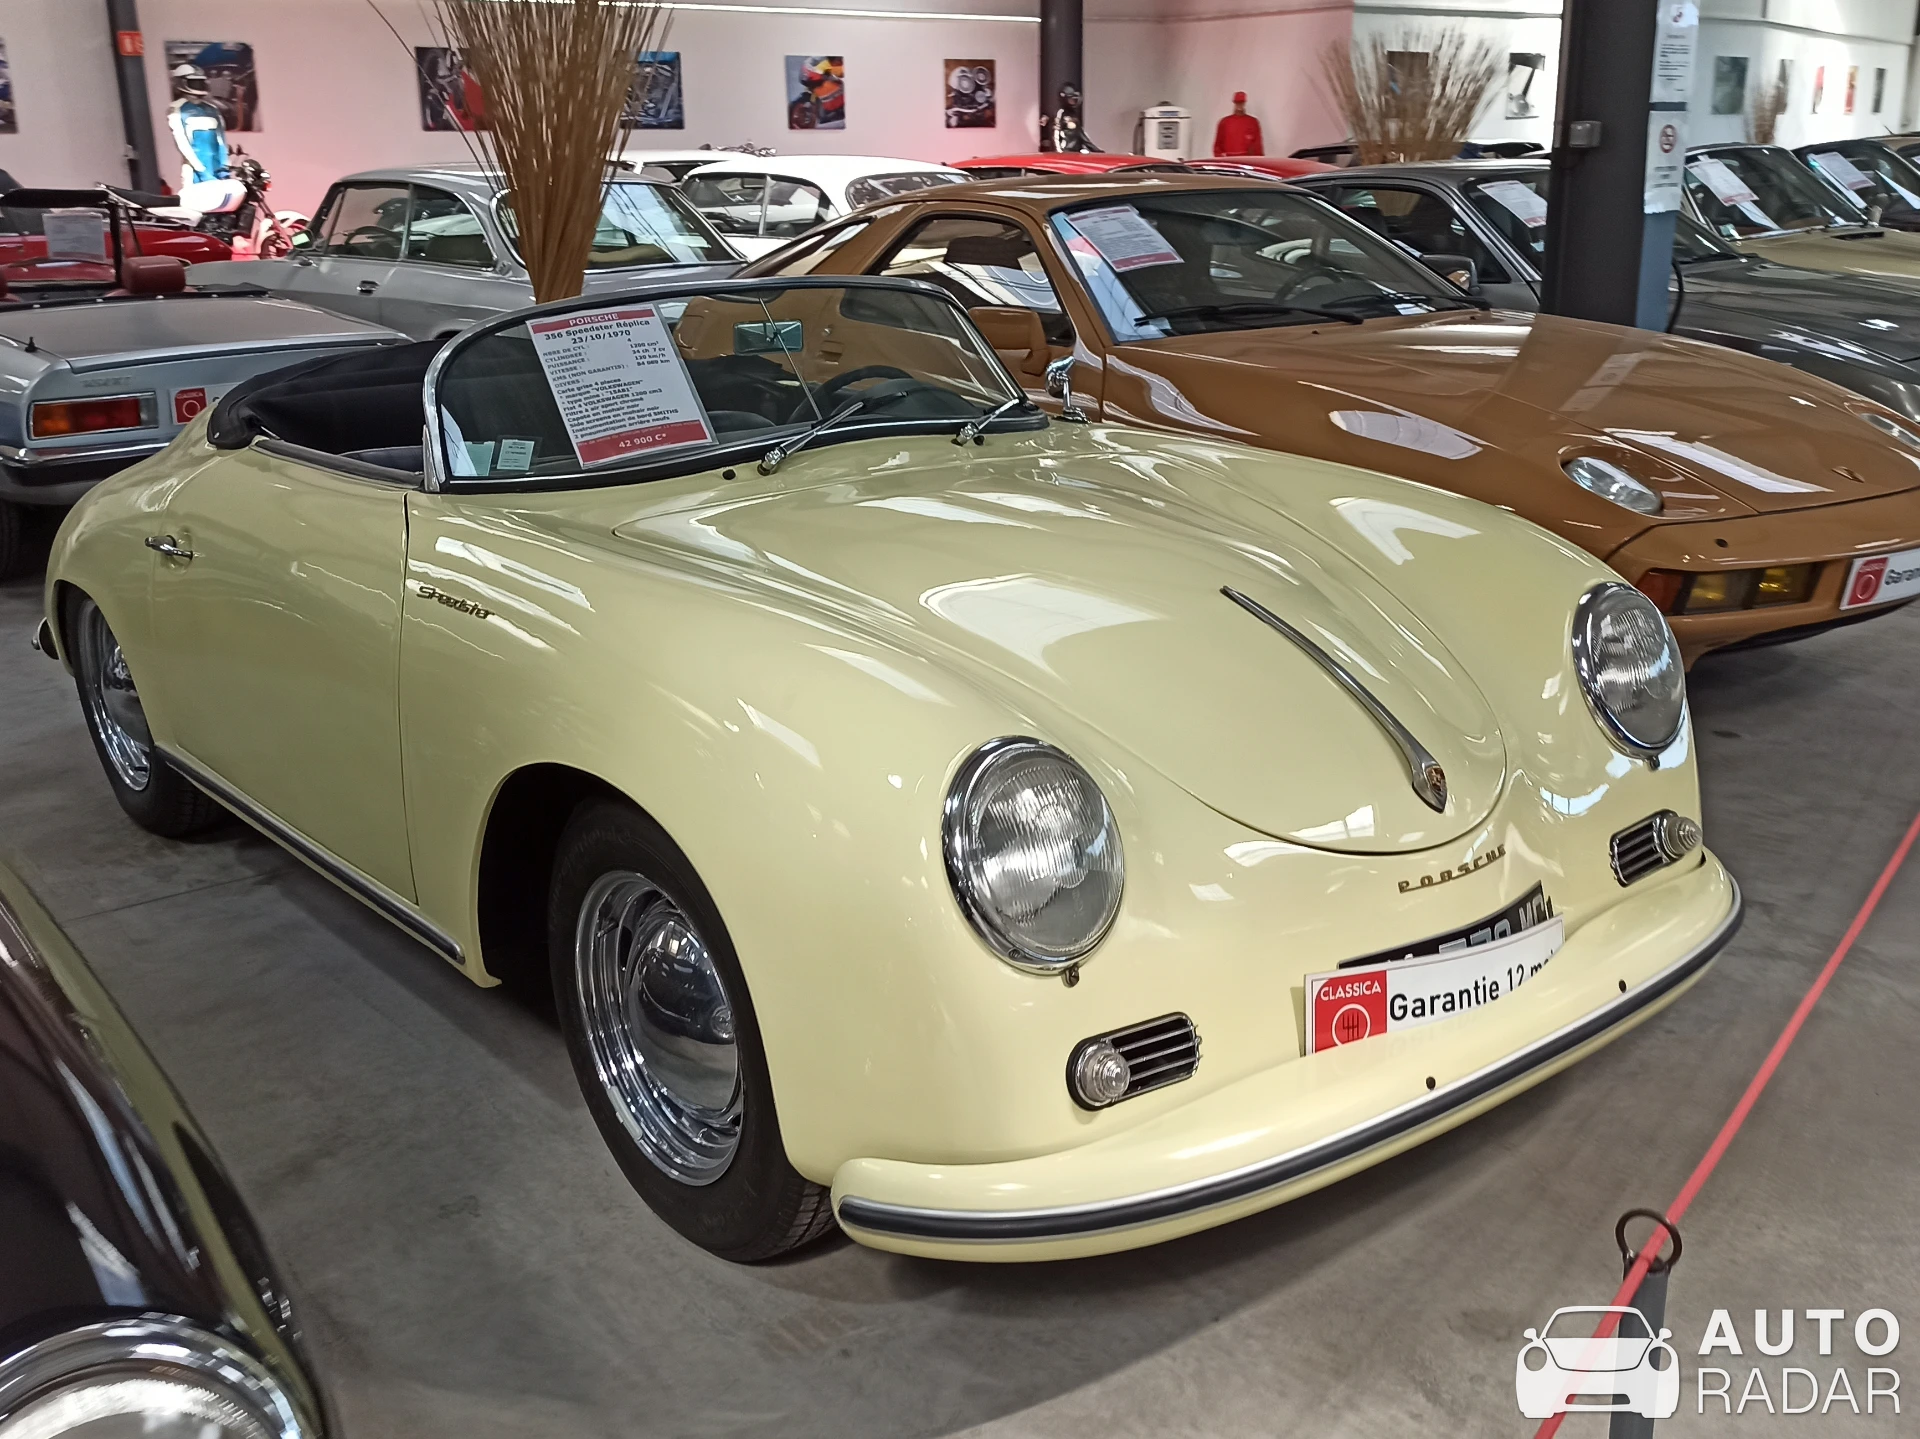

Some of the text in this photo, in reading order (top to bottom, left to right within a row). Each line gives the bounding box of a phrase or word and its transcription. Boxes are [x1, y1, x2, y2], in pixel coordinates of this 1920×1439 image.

[568, 313, 618, 326] PORSCHE
[566, 324, 614, 336] Speedster
[616, 320, 650, 328] Réplica
[571, 330, 630, 344] 23/10/1970
[548, 358, 585, 369] PUISSANCE
[550, 366, 578, 375] VITESSE
[553, 374, 567, 382] KMS
[555, 380, 580, 388] DIVERS
[566, 390, 590, 399] marque
[583, 393, 629, 406] VOLKSWAGEN
[620, 397, 644, 405] chromé
[568, 415, 590, 423] Capote
[602, 406, 625, 414] mohair
[586, 415, 611, 424] screens
[622, 408, 645, 416] mohair
[572, 418, 625, 433] Instrumentation
[580, 424, 627, 438] pneumatiques
[628, 419, 650, 427] arrière
[619, 440, 632, 448] 42
[634, 436, 652, 444] 900
[416, 586, 495, 619] Speedster
[1398, 844, 1506, 894] PORSCHE
[1320, 980, 1382, 1001] CLASSICA
[1389, 964, 1524, 1021] Garantie 12
